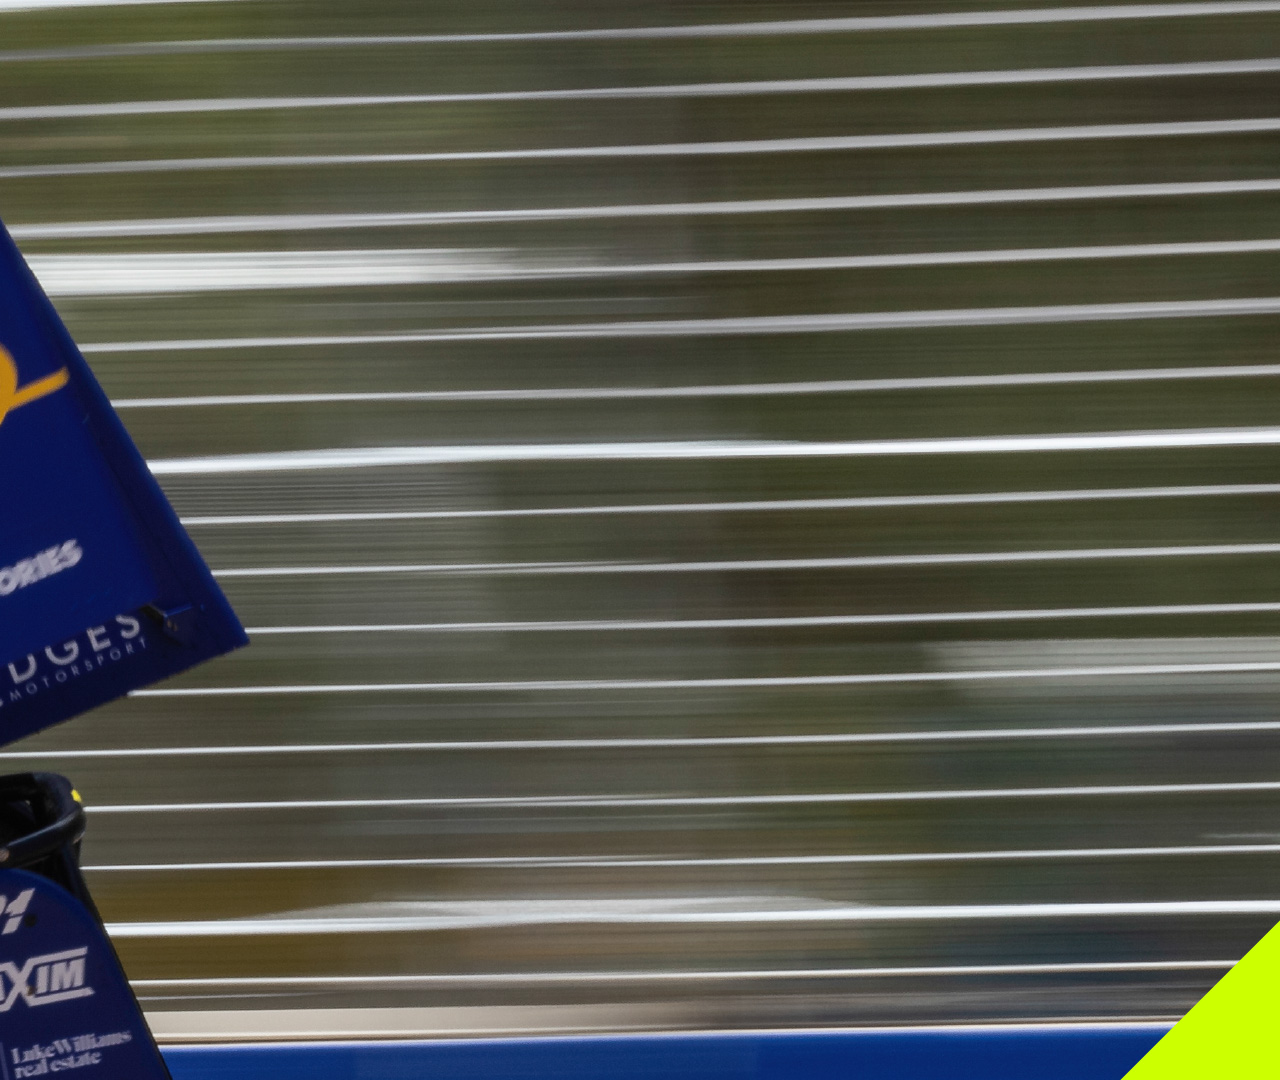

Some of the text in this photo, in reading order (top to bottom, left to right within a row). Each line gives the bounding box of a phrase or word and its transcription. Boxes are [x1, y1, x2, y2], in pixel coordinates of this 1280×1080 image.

[8, 636, 148, 703] MOTORSPORT
[14, 1052, 103, 1080] real estate
